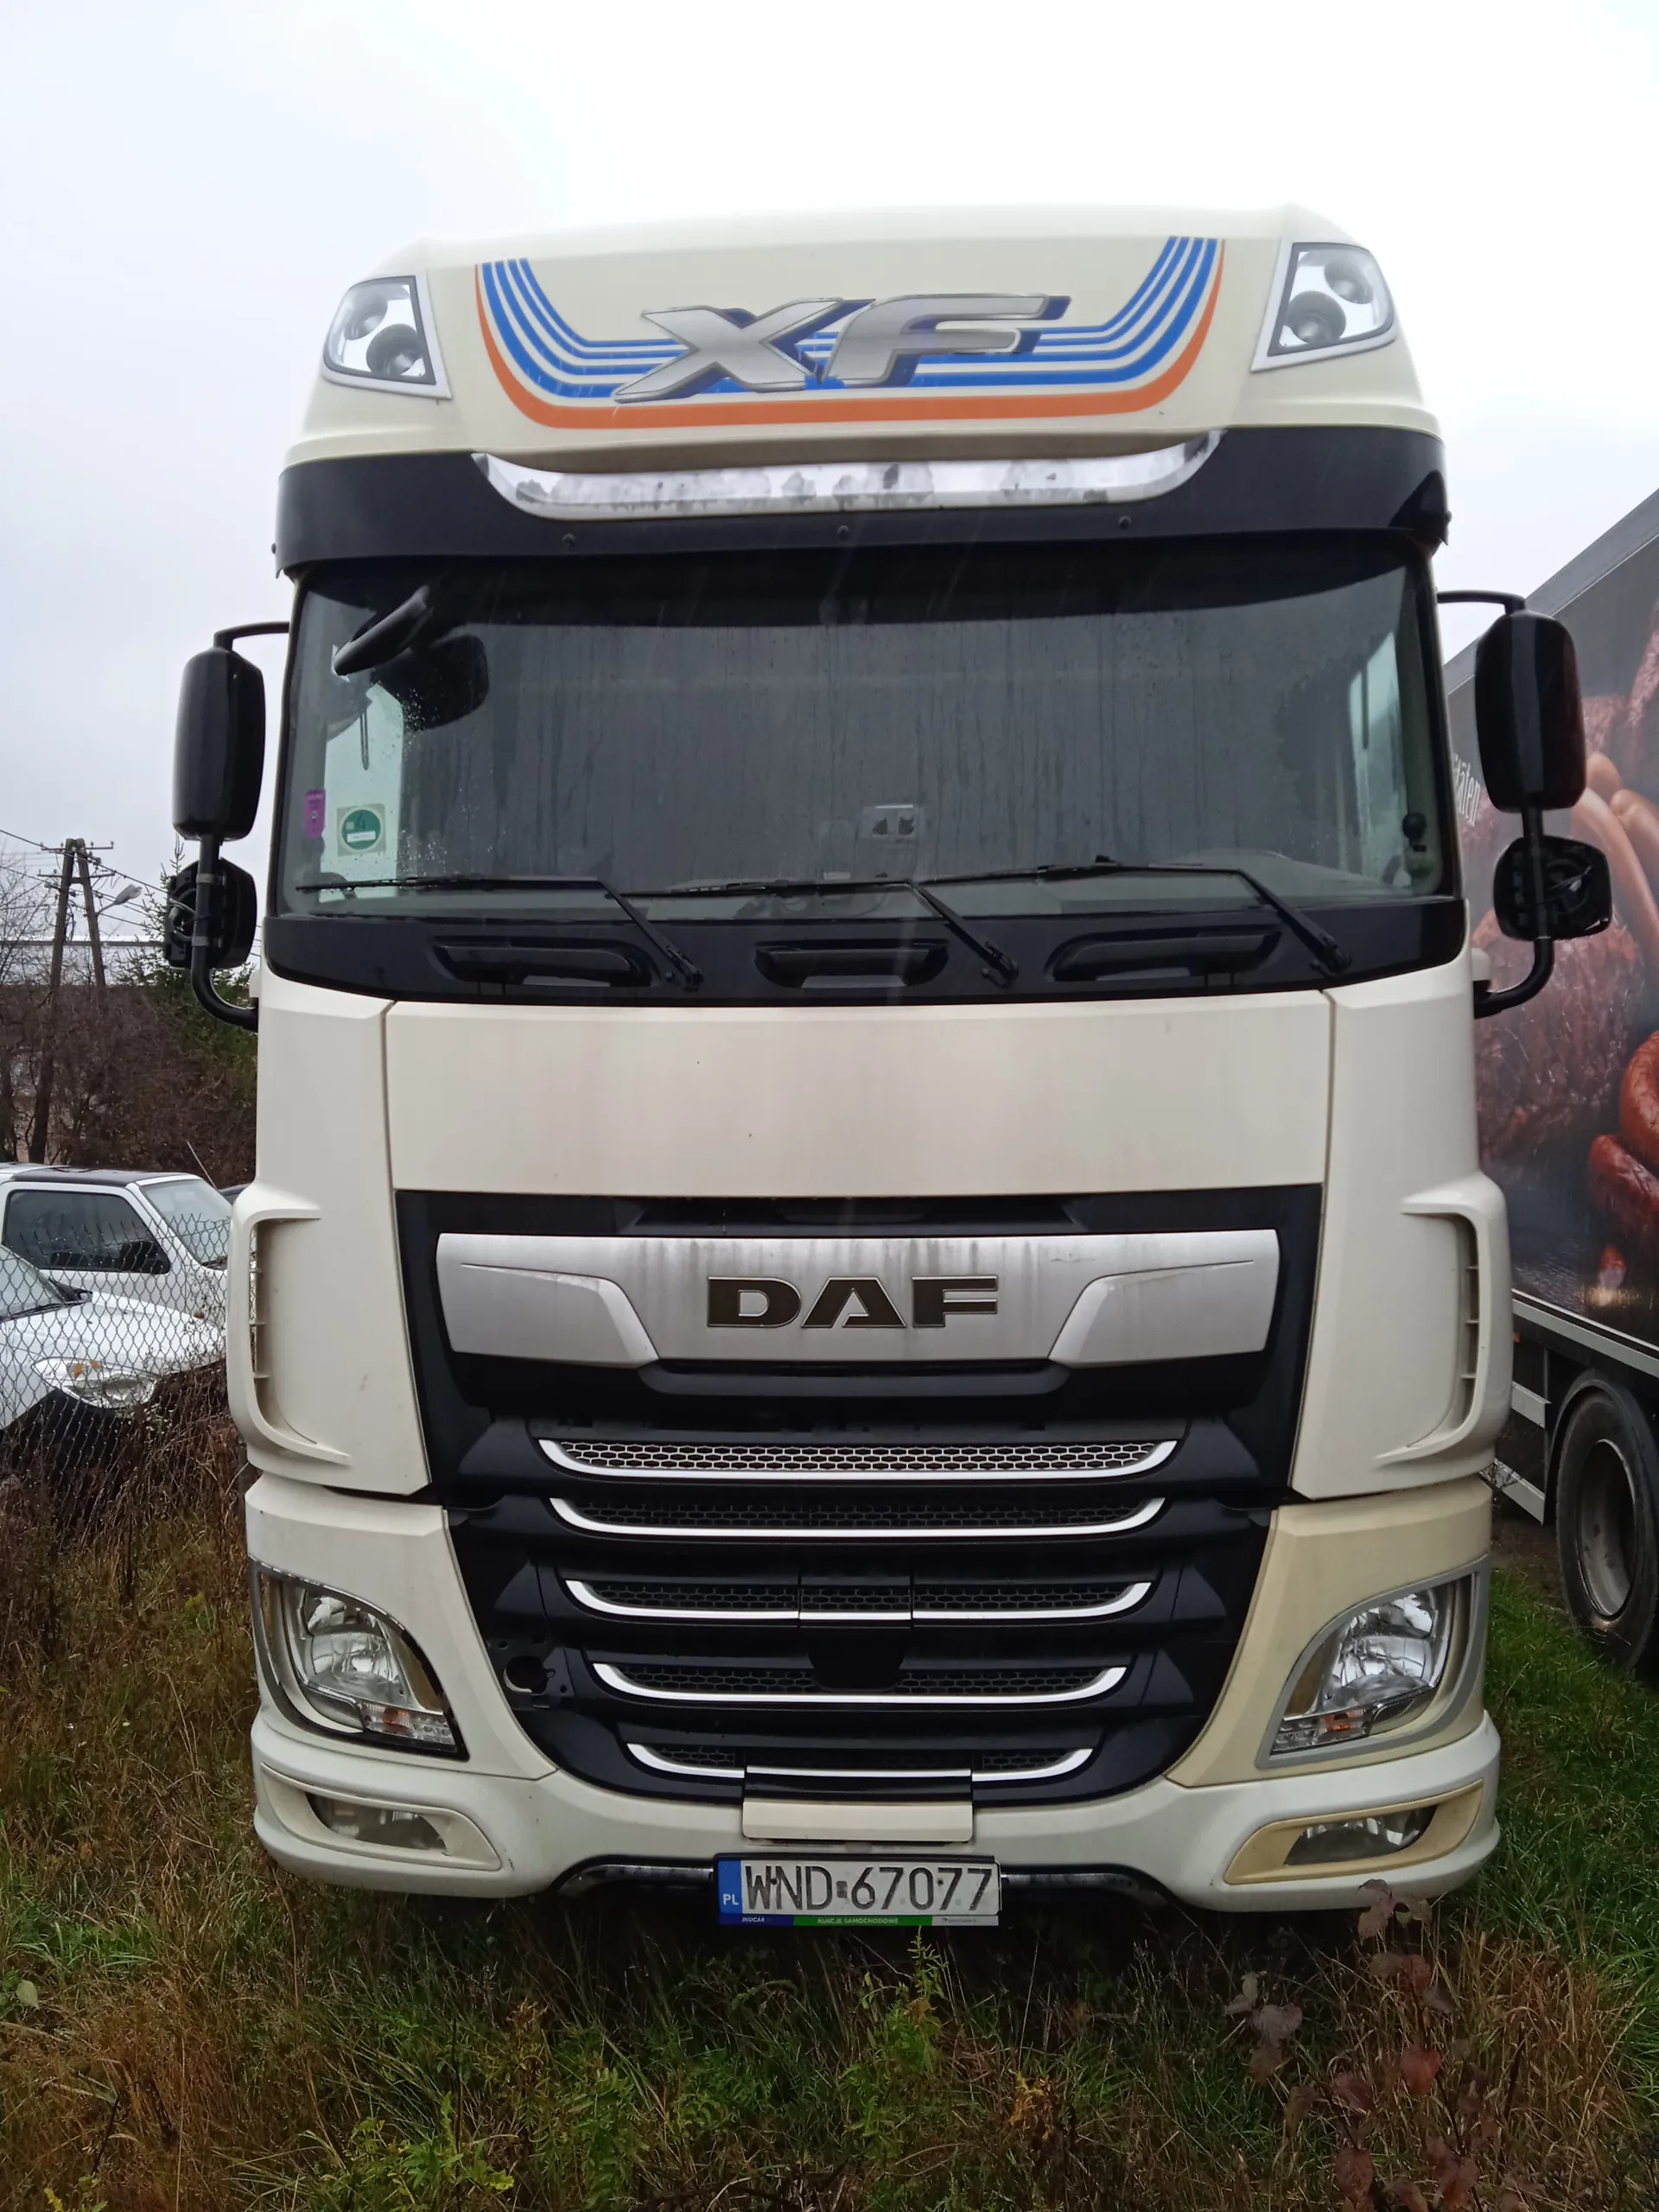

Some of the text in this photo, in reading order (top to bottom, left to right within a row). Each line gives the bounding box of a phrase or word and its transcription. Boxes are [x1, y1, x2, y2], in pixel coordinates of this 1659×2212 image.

[613, 293, 1068, 403] XF
[707, 1275, 998, 1328] DAF
[722, 1893, 739, 1906] PL
[744, 1865, 993, 1911] WND 67077
